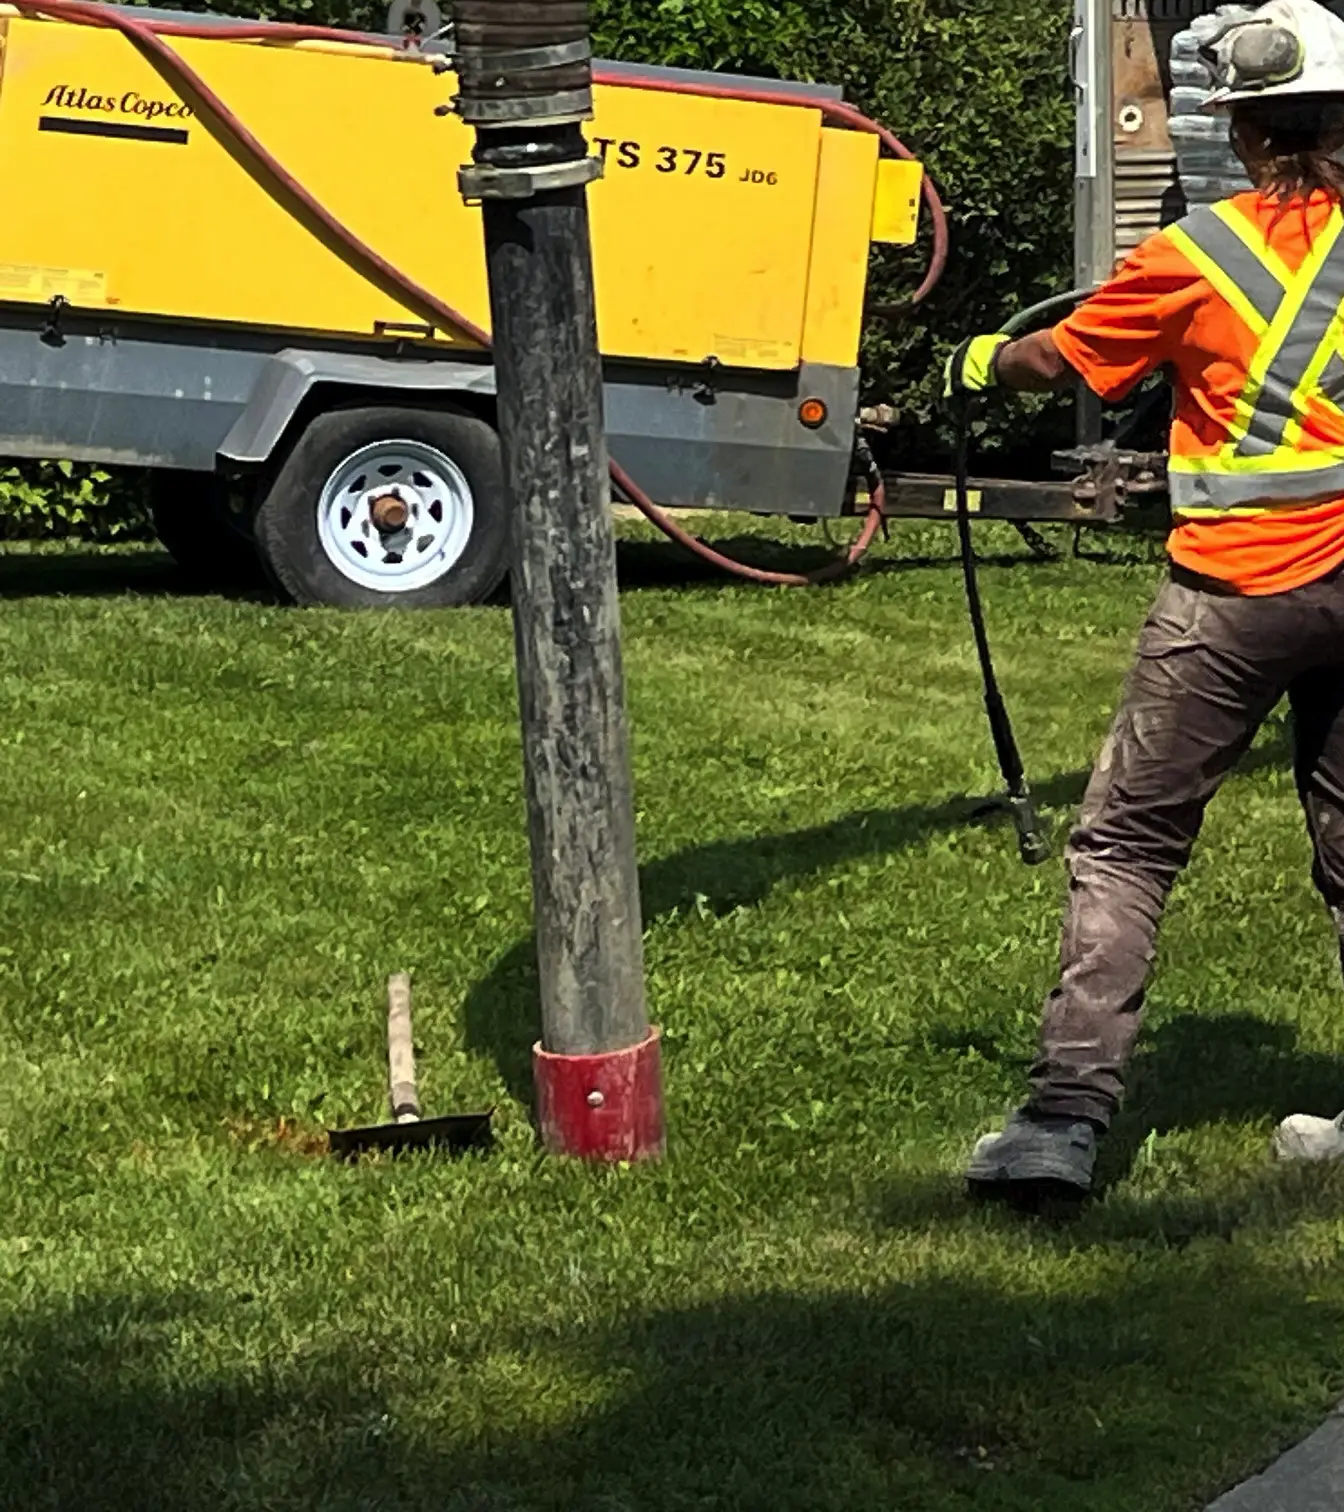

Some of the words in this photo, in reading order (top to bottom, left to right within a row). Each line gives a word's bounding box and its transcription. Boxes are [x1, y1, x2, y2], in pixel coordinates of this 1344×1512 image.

[41, 84, 116, 113] Atlas
[120, 91, 195, 120] Copco
[655, 146, 727, 179] 375
